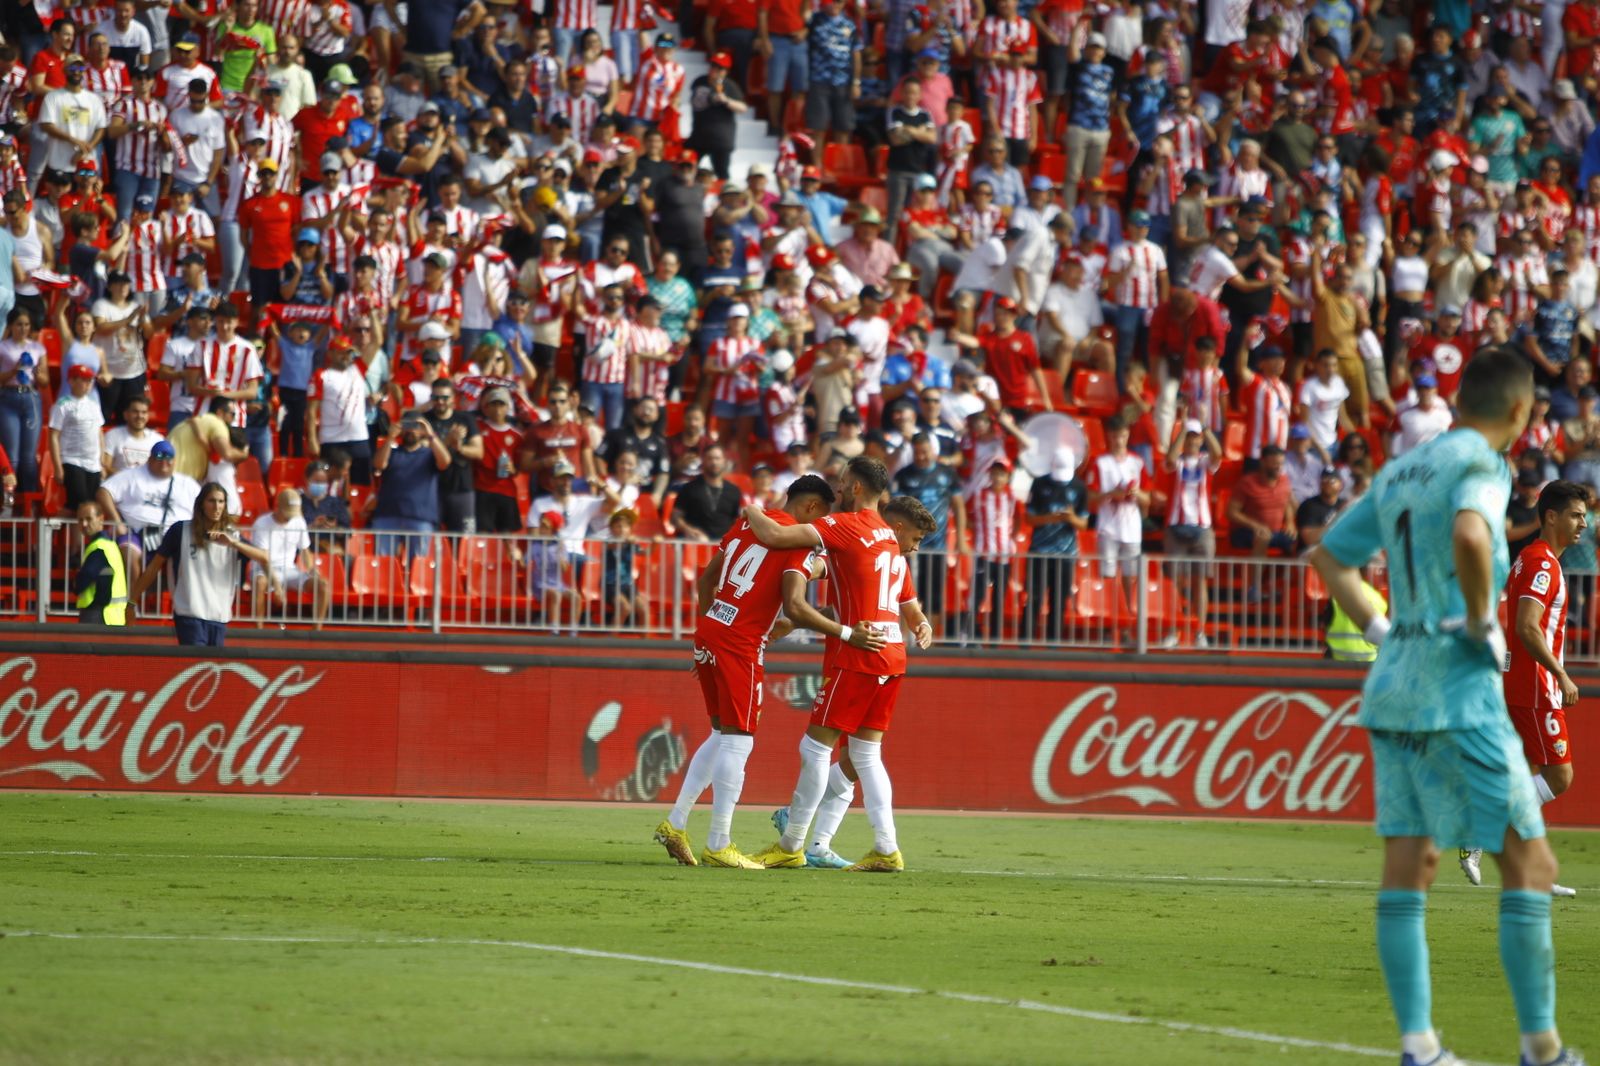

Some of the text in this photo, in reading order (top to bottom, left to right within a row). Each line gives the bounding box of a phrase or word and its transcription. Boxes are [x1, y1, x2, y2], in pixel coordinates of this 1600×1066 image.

[718, 538, 769, 600] 14
[874, 551, 907, 616] 12
[1396, 508, 1417, 603] 1
[1032, 686, 1365, 812] Coca-Cola
[1545, 711, 1561, 737] 6
